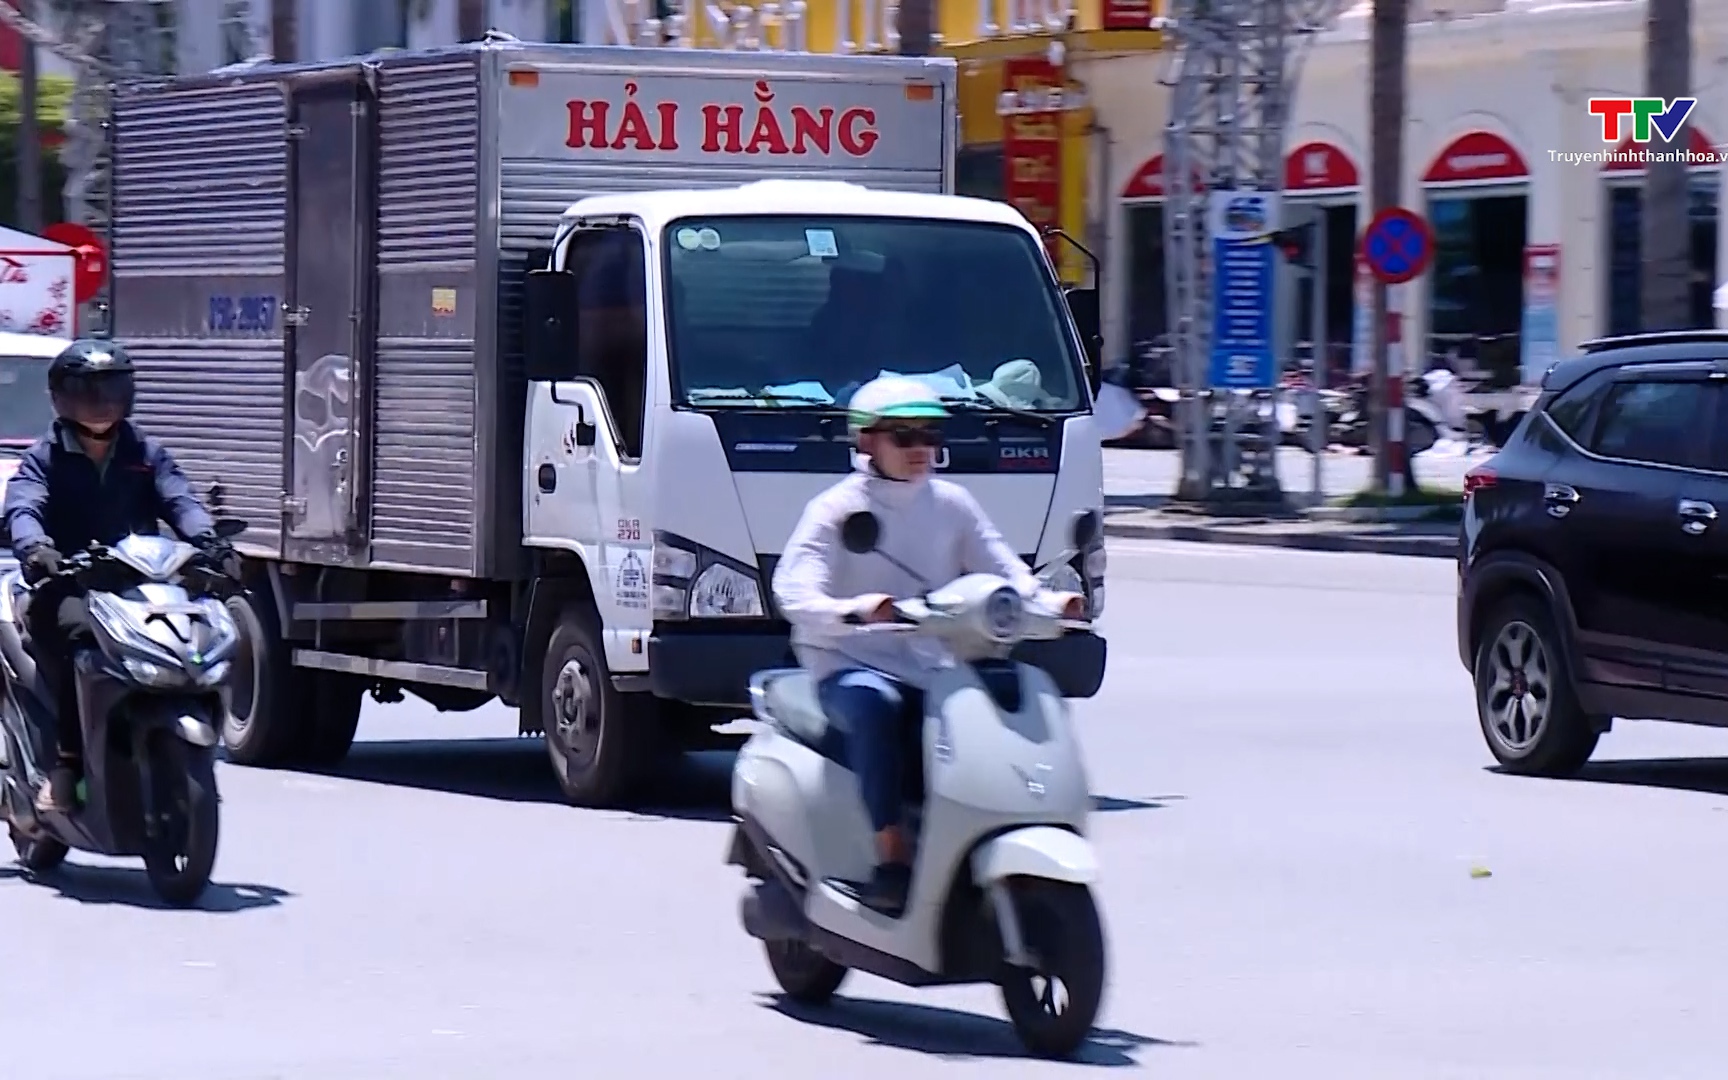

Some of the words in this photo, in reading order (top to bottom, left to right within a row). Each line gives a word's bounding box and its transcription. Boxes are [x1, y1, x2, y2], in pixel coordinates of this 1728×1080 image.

[565, 82, 679, 151] HẢI
[701, 80, 879, 156] HẰNG
[617, 529, 641, 540] 270
